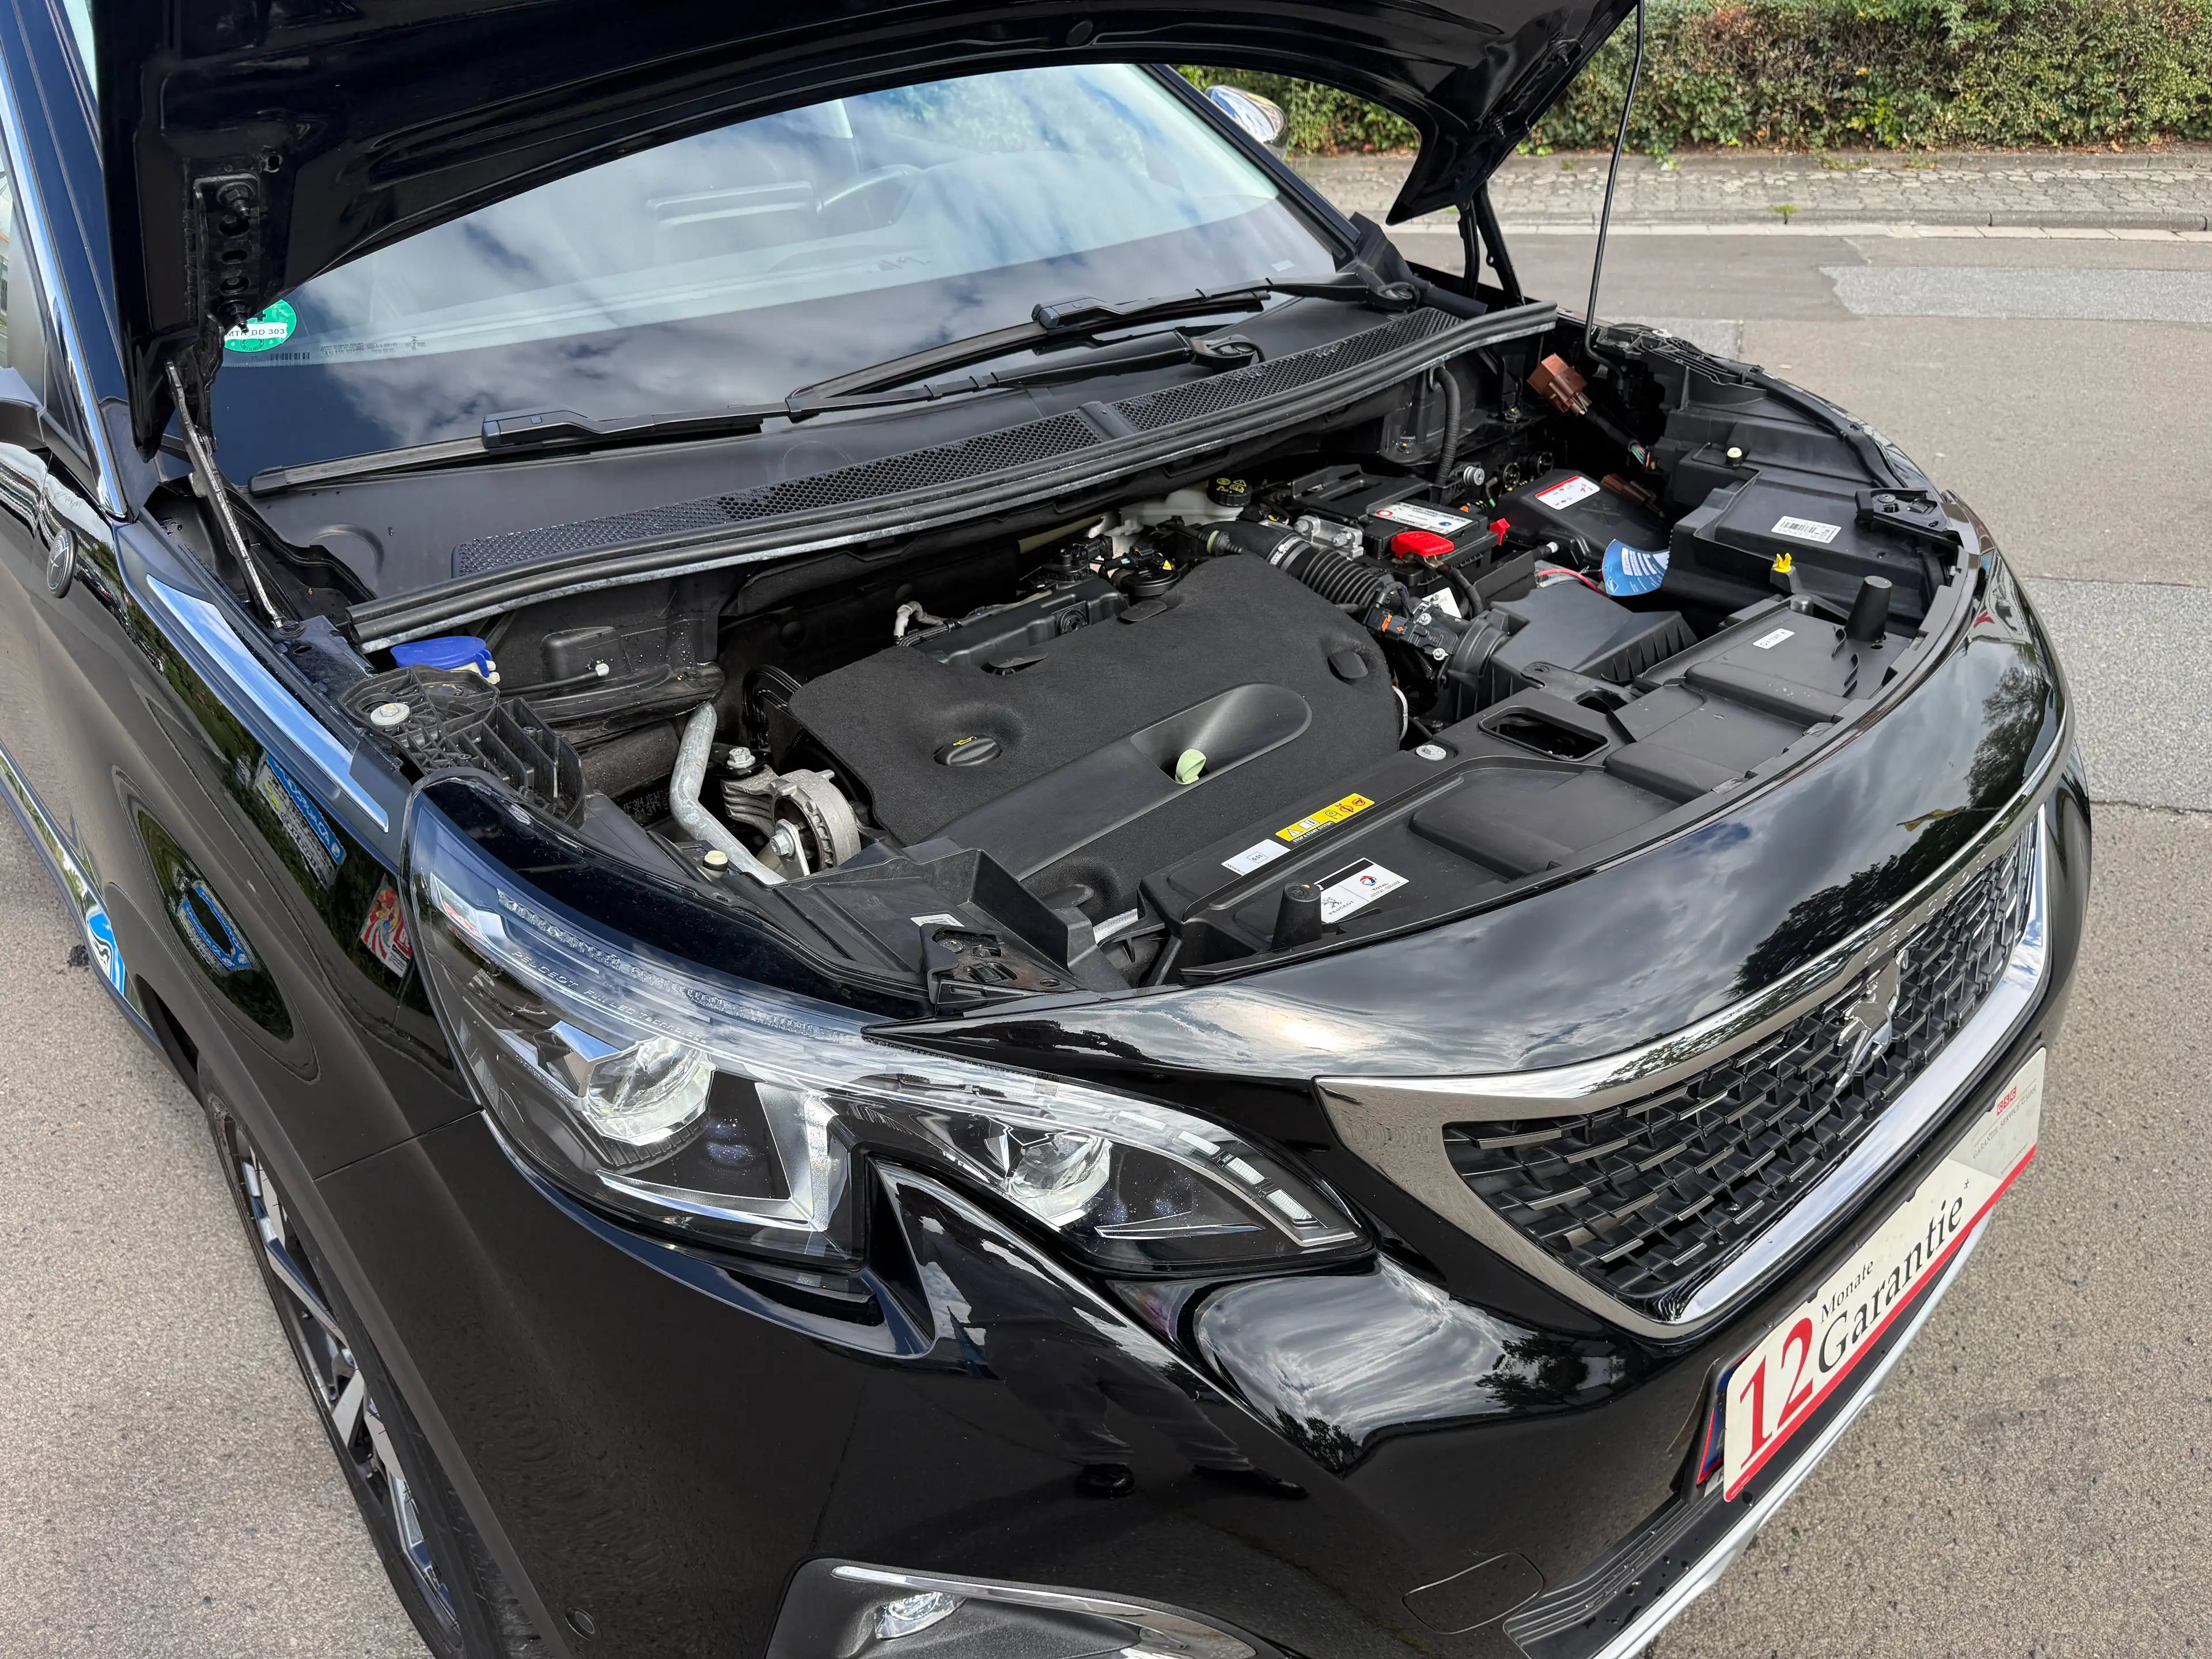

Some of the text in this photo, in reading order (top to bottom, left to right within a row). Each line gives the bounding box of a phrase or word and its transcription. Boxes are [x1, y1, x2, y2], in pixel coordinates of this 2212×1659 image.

[1318, 821, 1333, 830] SYSTEM
[1372, 882, 1389, 891] TOTAL
[1328, 900, 1354, 915] PEUGEOT
[512, 951, 578, 987] PEUGEOT
[609, 1002, 635, 1015] LED
[1997, 1087, 2017, 1115] GSG
[1821, 1261, 1873, 1324] Monate
[1740, 1317, 1813, 1469] 12
